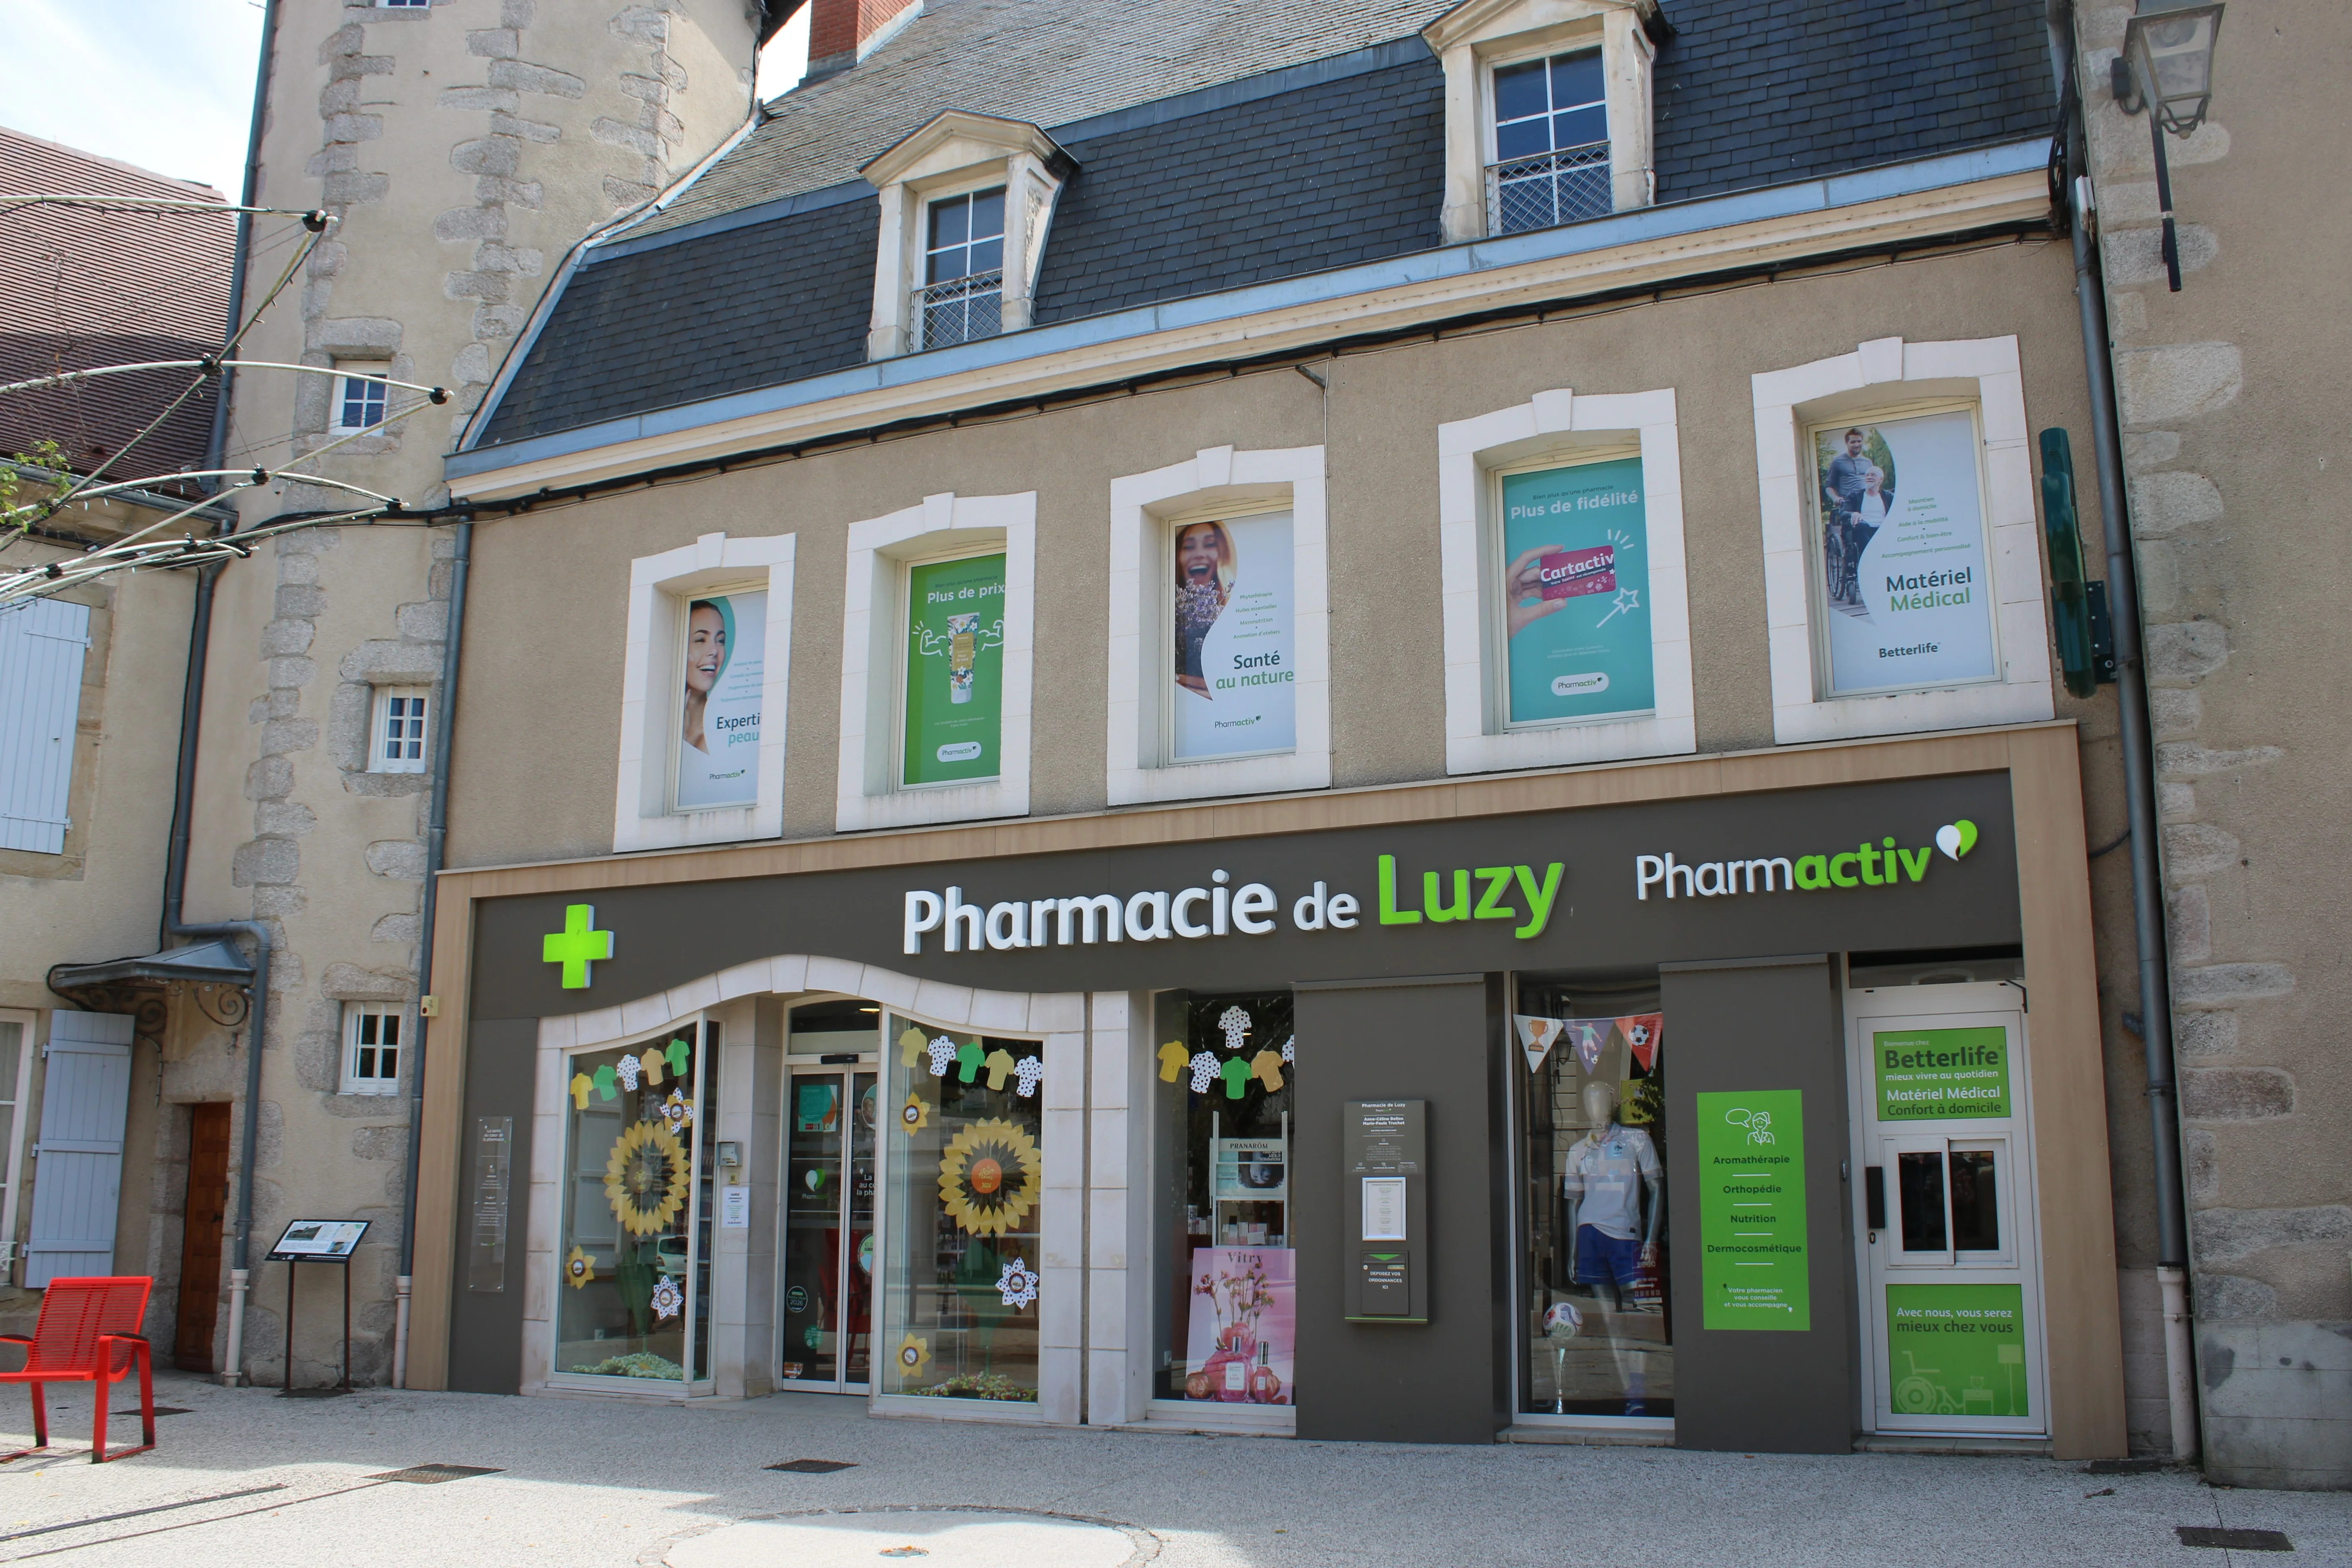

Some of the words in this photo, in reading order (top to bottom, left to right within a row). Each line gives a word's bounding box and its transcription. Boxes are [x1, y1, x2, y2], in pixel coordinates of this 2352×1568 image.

[1583, 485, 1613, 494] pharmacie
[1511, 505, 1545, 519] Plus
[1551, 501, 1571, 514] de
[1577, 490, 1638, 510] fidélité
[1881, 549, 1933, 558] Accompagnement
[1934, 543, 1971, 553] personnalisé
[1541, 553, 1614, 582] Cartactiv
[1886, 566, 1971, 592] Matériel
[928, 591, 954, 603] Plus
[958, 587, 975, 599] de
[979, 583, 1005, 598] prix
[1240, 592, 1273, 600] Phytothérapie
[1891, 587, 1970, 612] Médical
[1879, 643, 1938, 658] Betterlife
[1233, 650, 1280, 669] Santé
[1216, 677, 1236, 689] au
[1558, 679, 1597, 689] Pharmactiv
[717, 712, 762, 731] Experti
[1215, 718, 1255, 728] Pharmactiv
[728, 732, 759, 747] peau
[942, 748, 972, 756] Pharmactiv
[710, 771, 741, 780] Pharmactiv
[1636, 836, 1933, 901] Pharmactiv
[903, 869, 1279, 955] Pharmacie
[1293, 881, 1360, 931] de
[1378, 854, 1566, 940] Luzy
[1954, 1070, 1998, 1081] quotidien
[1887, 1088, 1943, 1101] Matériel
[1948, 1086, 2000, 1099] Médical
[1888, 1104, 1934, 1116] Confort
[1938, 1104, 1945, 1114] à
[1949, 1102, 2001, 1113] domicile
[1713, 1155, 1790, 1164] Aromathérapie
[1723, 1185, 1781, 1194] Orthopédie
[1707, 1244, 1801, 1253] Dermocosmétique
[1227, 1252, 1263, 1264] Vitry
[1896, 1307, 1922, 1317] Avec
[1925, 1309, 1953, 1318] nous,
[1897, 1320, 1940, 1332] mieux
[1944, 1320, 1975, 1332] chez
[1980, 1323, 2013, 1333] vous
